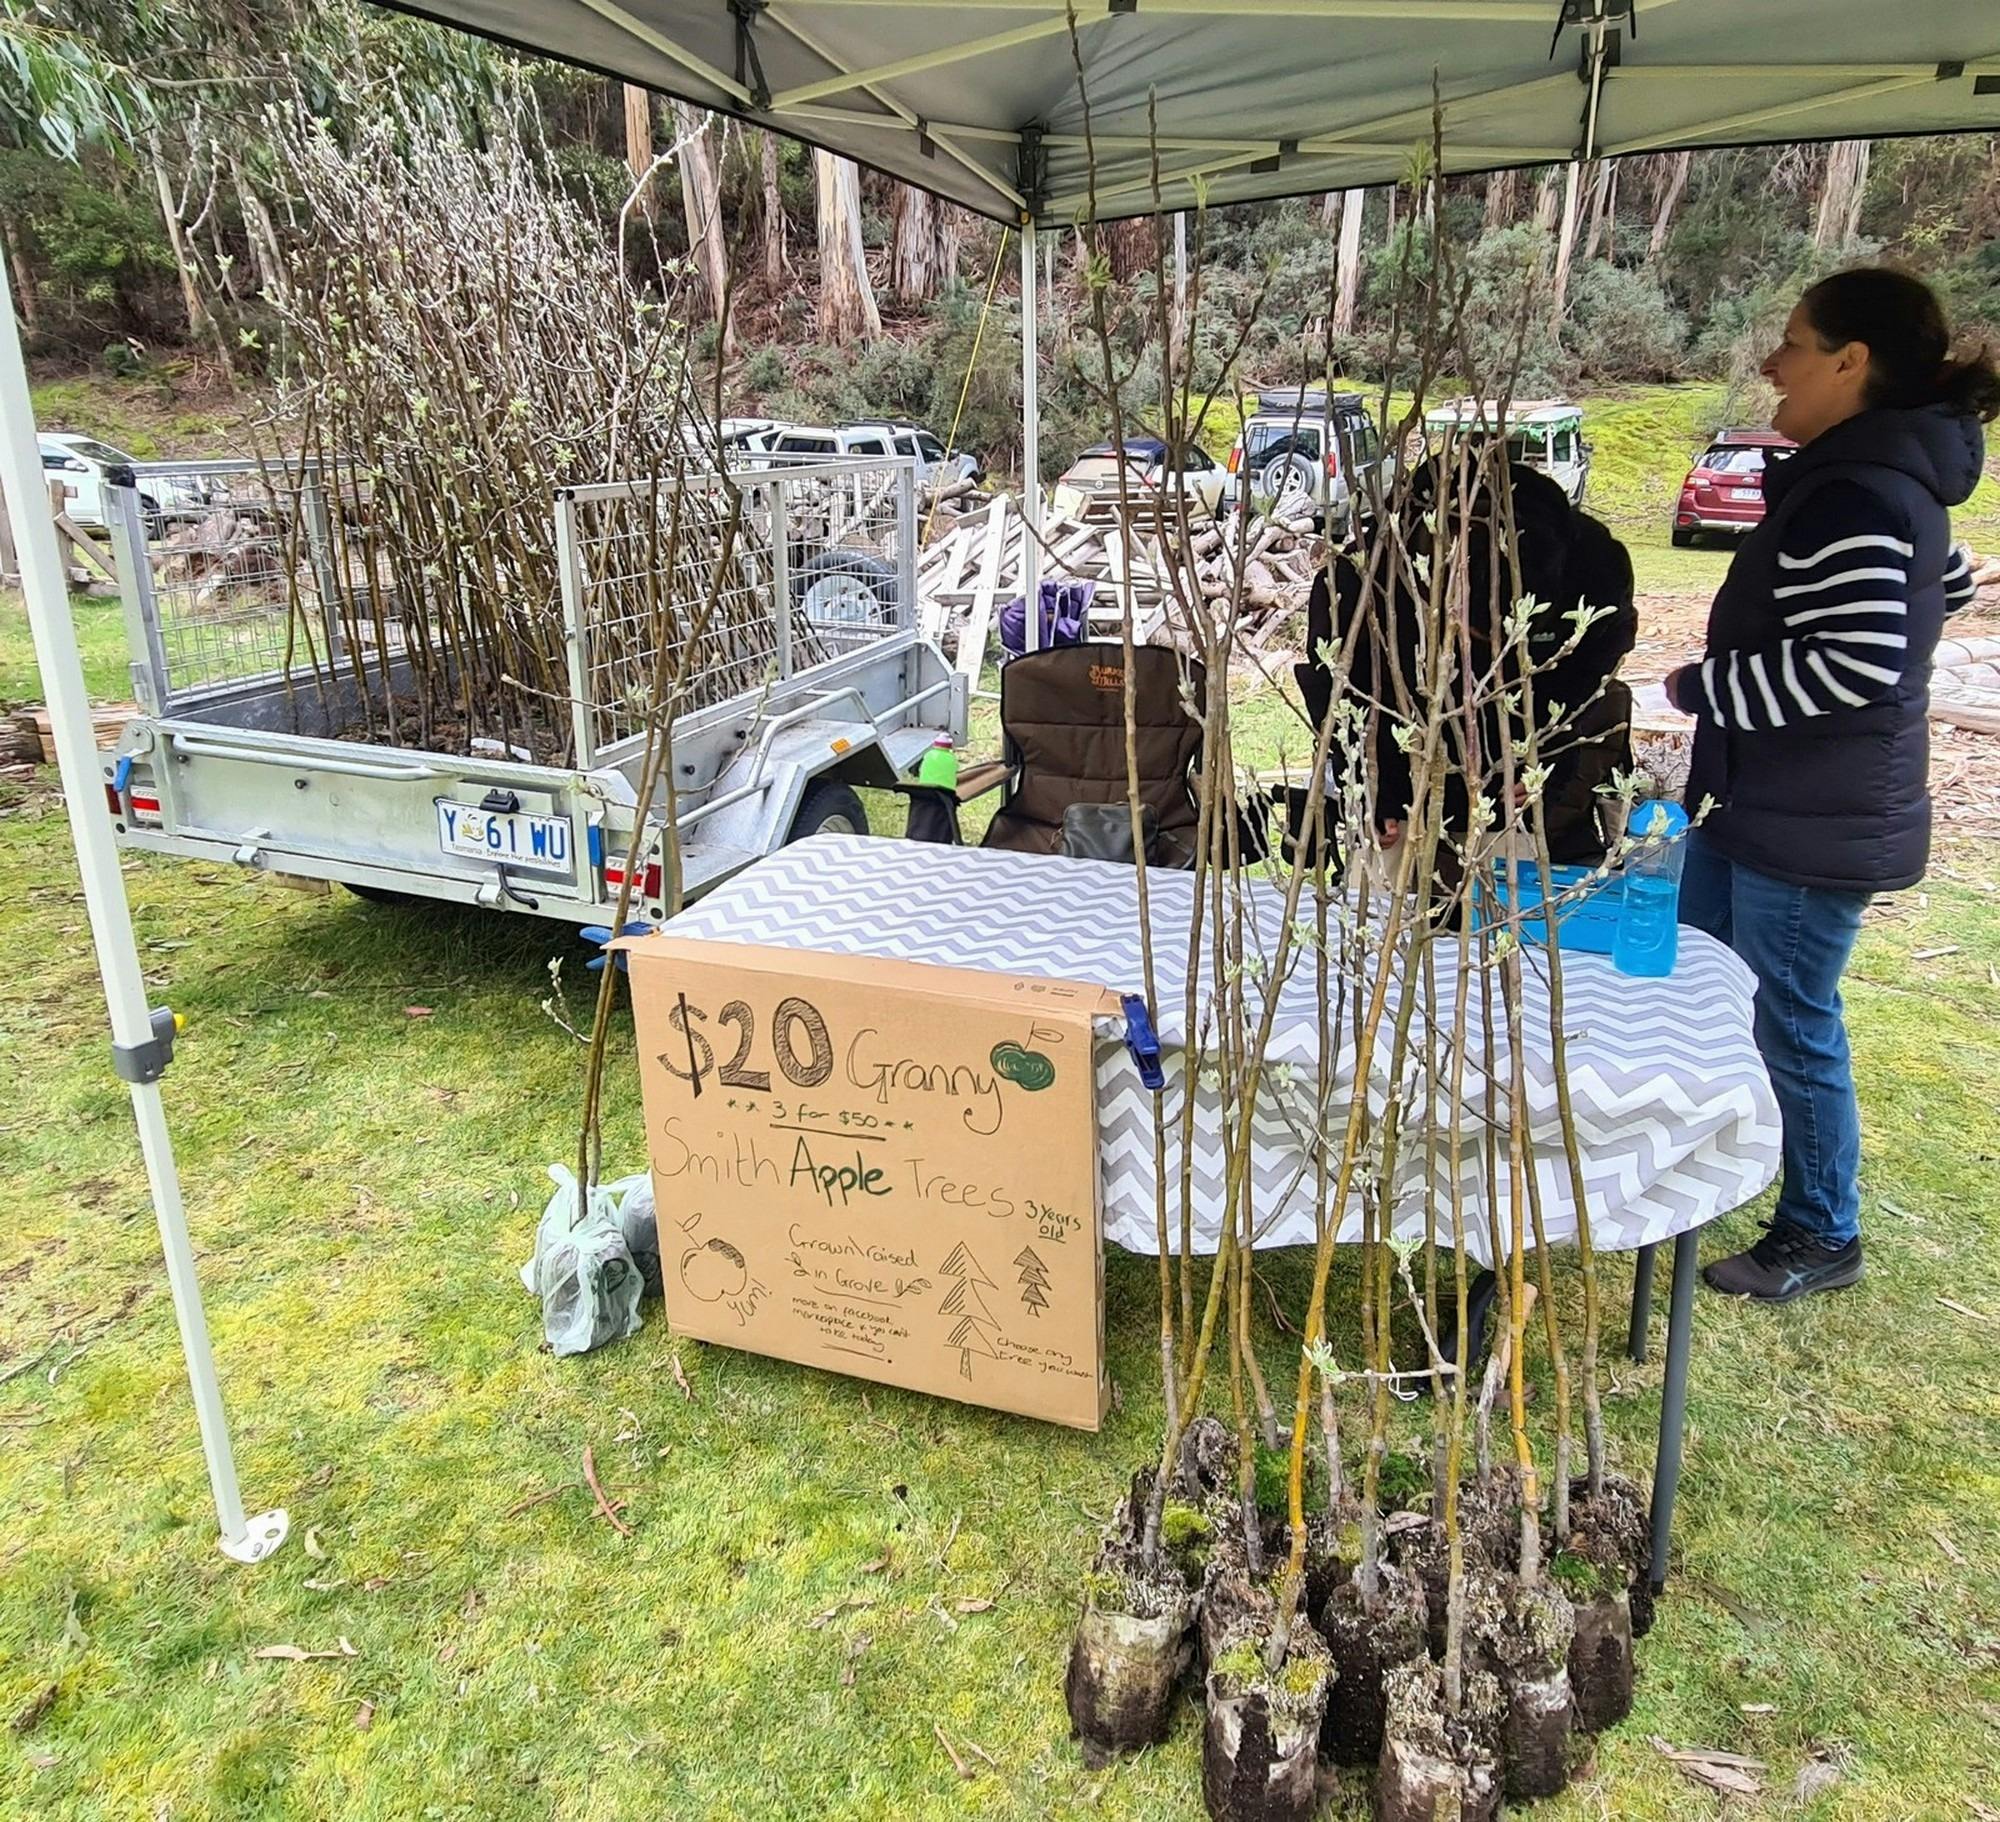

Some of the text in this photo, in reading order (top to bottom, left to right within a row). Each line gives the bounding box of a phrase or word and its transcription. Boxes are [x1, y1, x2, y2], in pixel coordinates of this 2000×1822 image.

[443, 808, 565, 860] Y 61 WU
[656, 992, 1003, 1135] $20 Granny
[772, 1101, 879, 1129] 3 for $50
[653, 1117, 1015, 1218] Smith Apple Trees
[1024, 1200, 1082, 1231] 3 Years
[1039, 1224, 1065, 1239] old
[815, 1268, 889, 1293] in Grove
[792, 1297, 820, 1310] more
[824, 1303, 838, 1312] on
[852, 1333, 886, 1353] today
[1038, 1360, 1064, 1374] you
